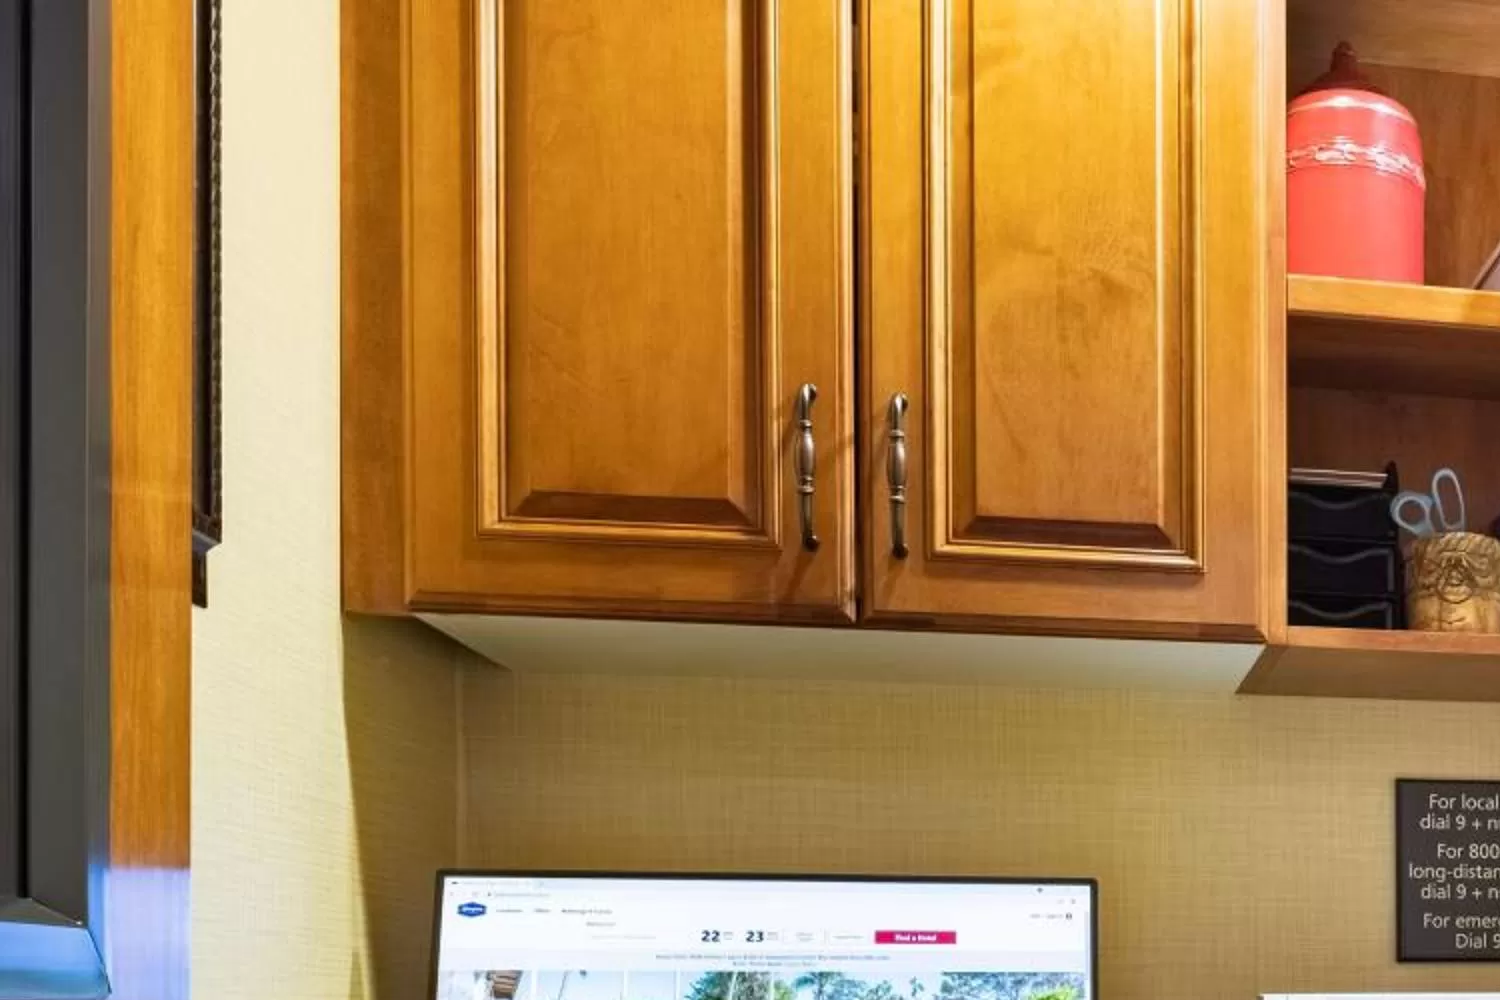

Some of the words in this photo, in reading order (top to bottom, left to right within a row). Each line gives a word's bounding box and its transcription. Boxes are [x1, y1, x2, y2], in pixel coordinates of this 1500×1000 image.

[1429, 794, 1456, 809] For
[1461, 794, 1499, 810] local
[1420, 814, 1450, 830] dial
[1456, 815, 1465, 830] 9
[1472, 819, 1482, 831] +
[1437, 843, 1463, 859] For
[1469, 844, 1500, 859] 800
[1421, 884, 1450, 900] dial
[1456, 885, 1466, 900] 9
[1472, 888, 1482, 899] +
[1423, 913, 1450, 928] For
[701, 930, 720, 942] 22
[745, 930, 764, 942] 23
[1456, 933, 1487, 949] Dial
